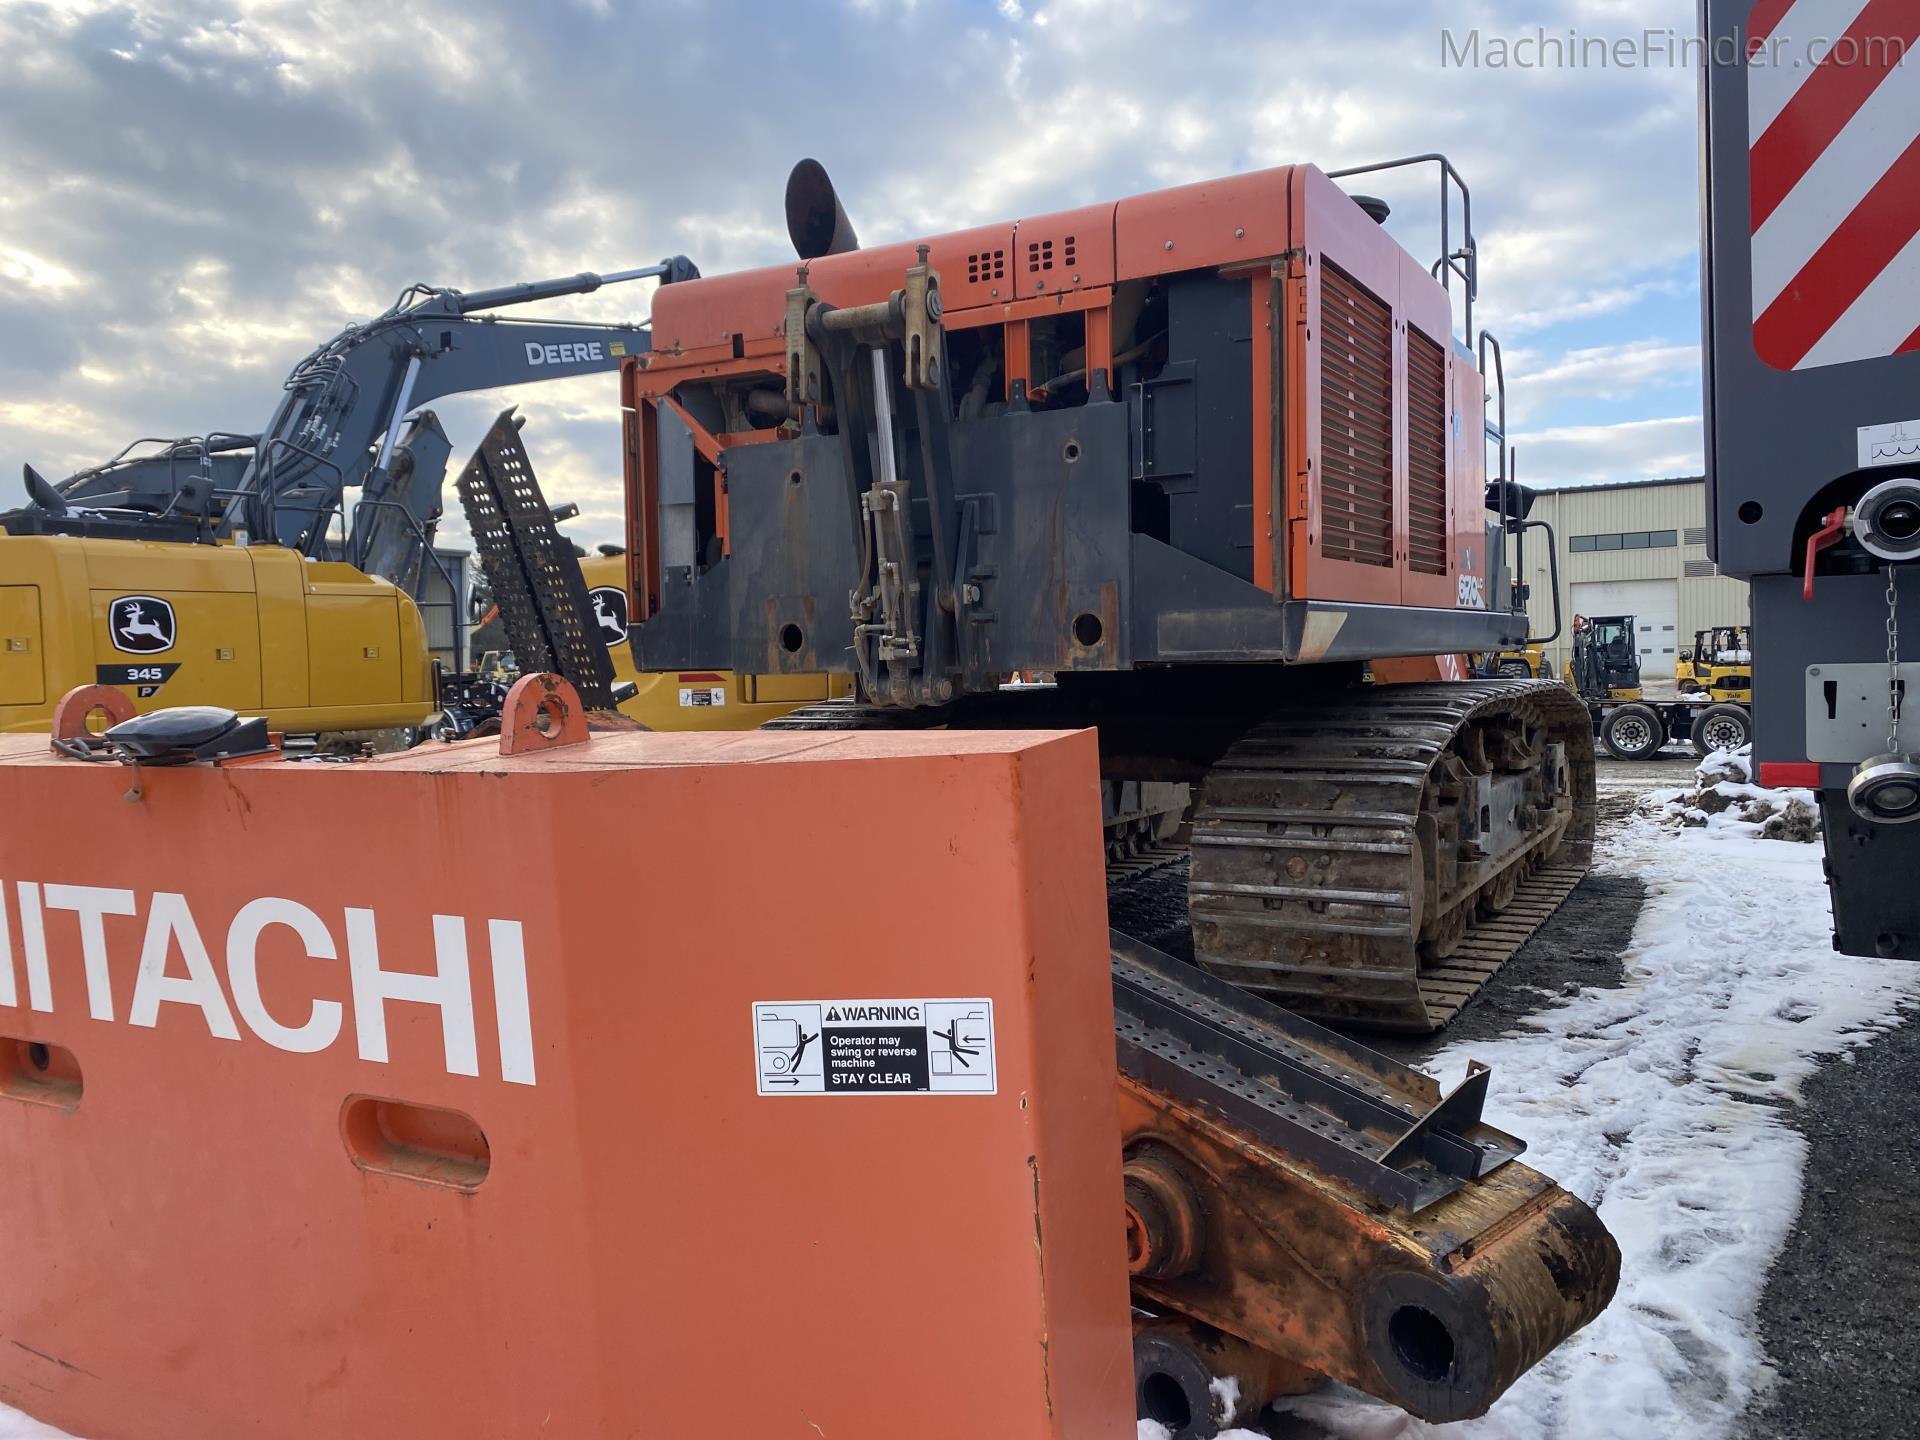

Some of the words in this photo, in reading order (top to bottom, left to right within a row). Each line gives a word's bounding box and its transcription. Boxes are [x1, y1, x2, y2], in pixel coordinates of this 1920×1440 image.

[524, 342, 604, 366] DEERE
[127, 668, 162, 680] 345
[141, 687, 152, 697] P
[842, 1006, 920, 1021] WARNING
[830, 1036, 876, 1048] Operator
[878, 1036, 900, 1046] may
[830, 1048, 862, 1059] swing
[878, 1048, 917, 1056] reverse
[831, 1058, 876, 1068] machine
[832, 1073, 865, 1085] STAY
[868, 1073, 912, 1085] CLEAR
